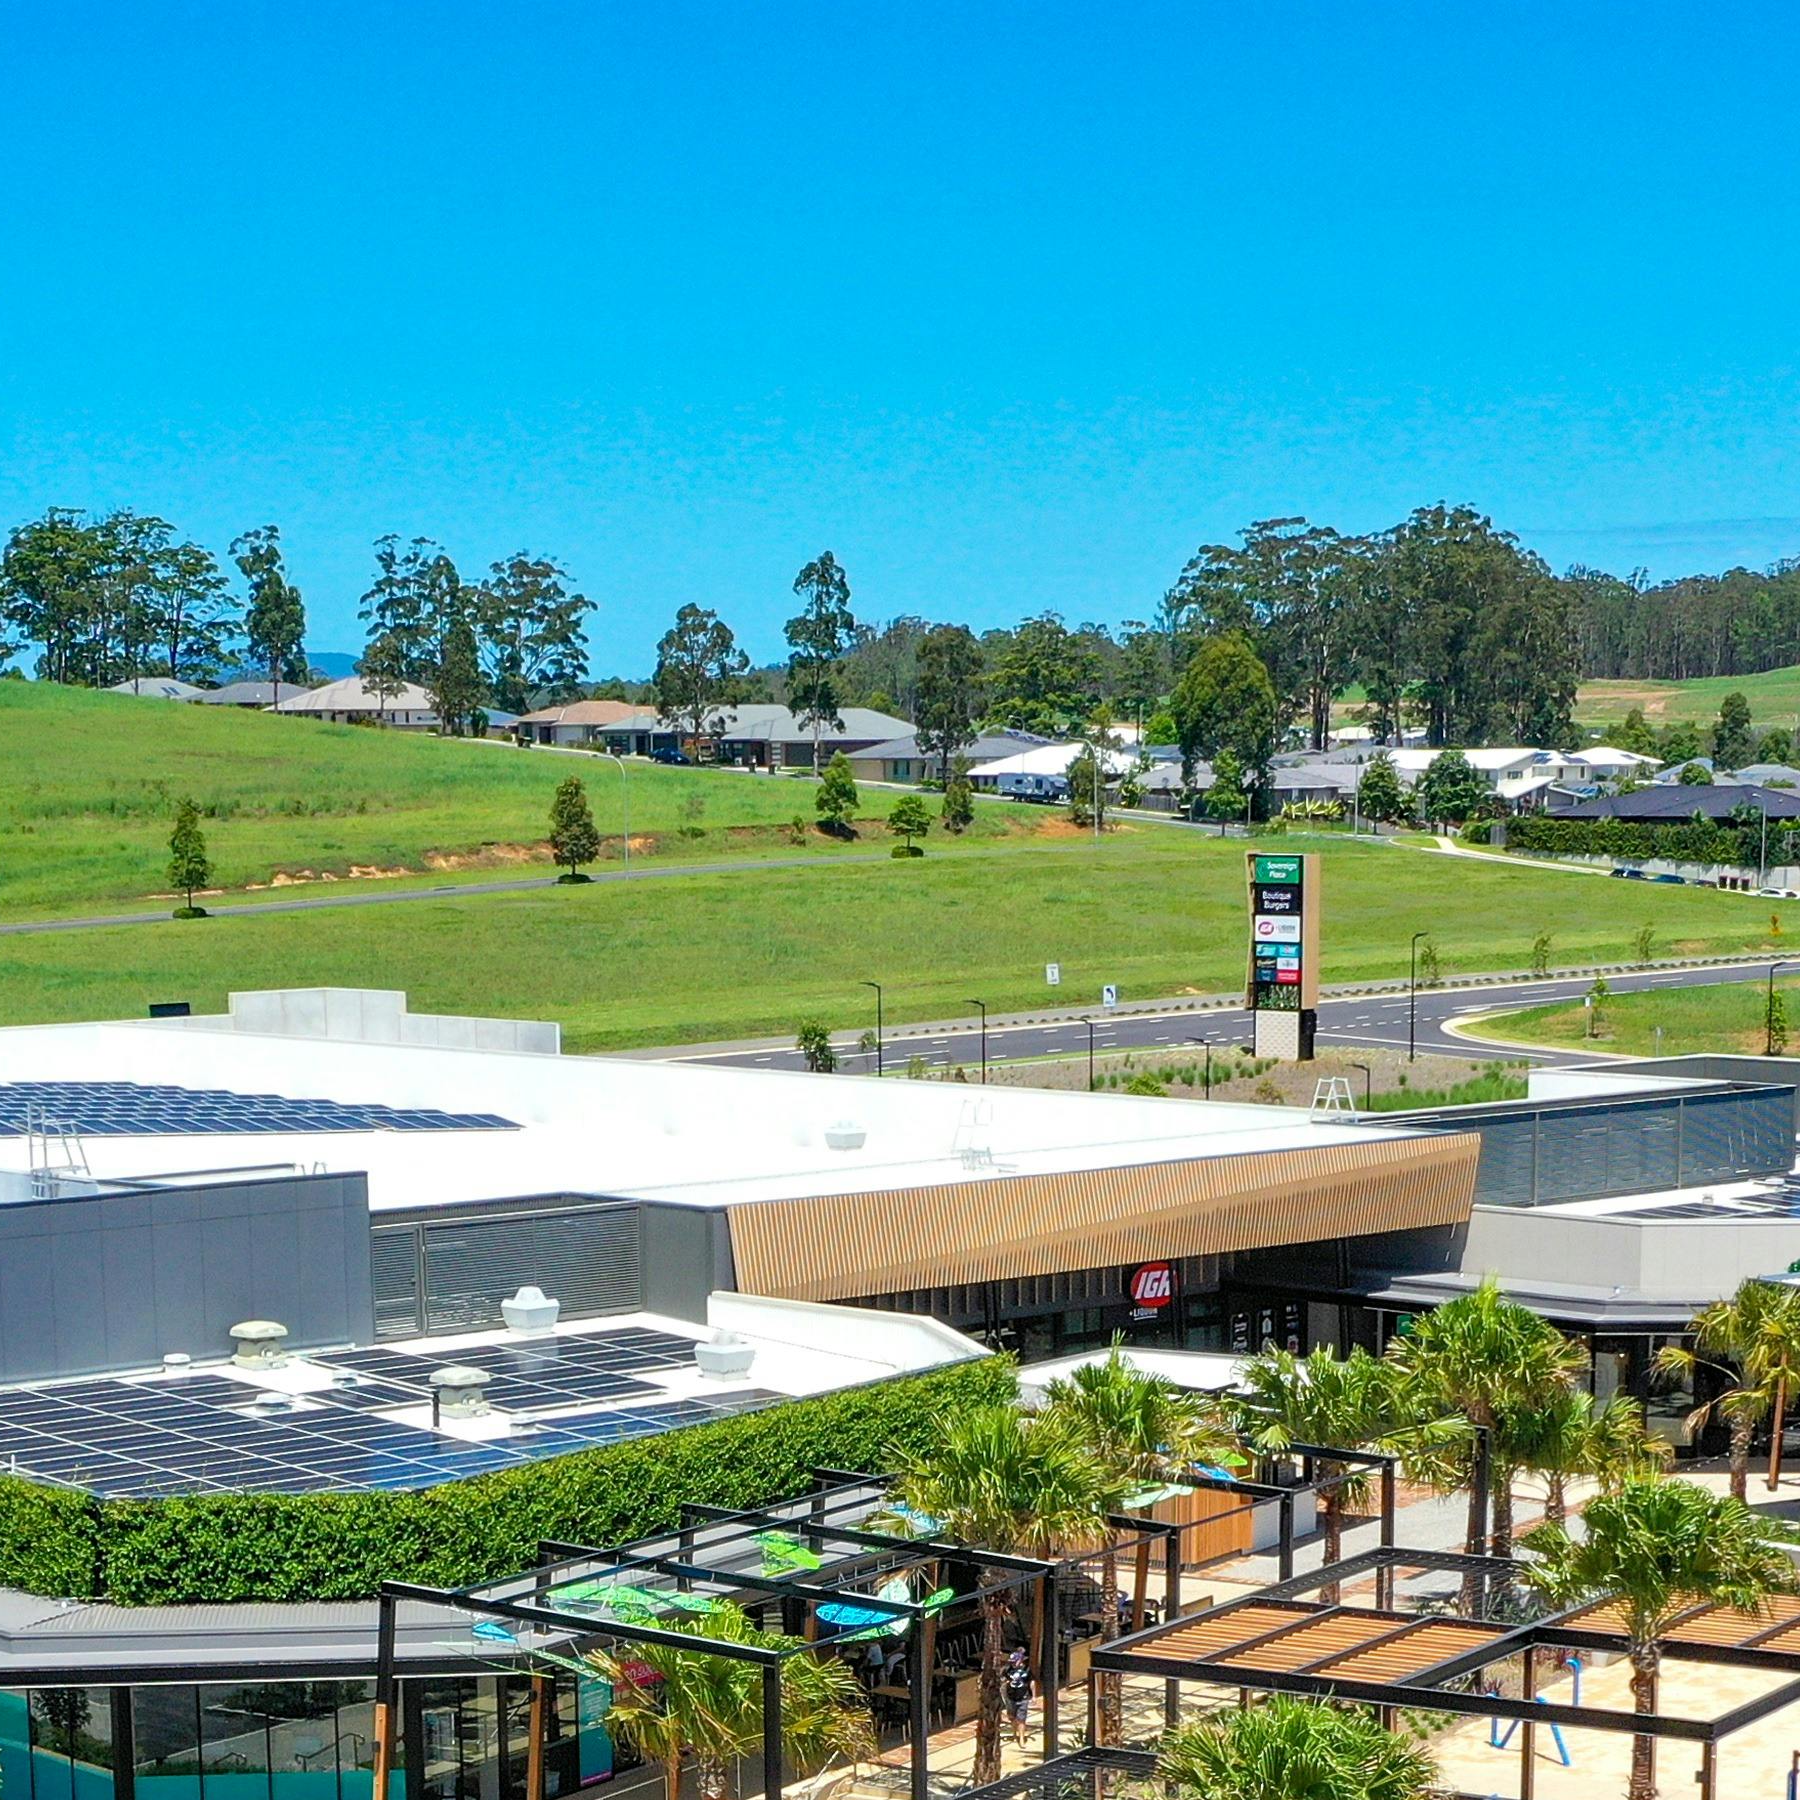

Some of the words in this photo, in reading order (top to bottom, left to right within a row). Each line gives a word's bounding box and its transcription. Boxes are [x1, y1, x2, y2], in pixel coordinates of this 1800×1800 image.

[1267, 861, 1298, 871] Sovereign
[1269, 870, 1287, 878] Place
[1262, 890, 1291, 900] Boutique
[1264, 900, 1290, 911] Burgers
[1135, 1269, 1173, 1300] IGA
